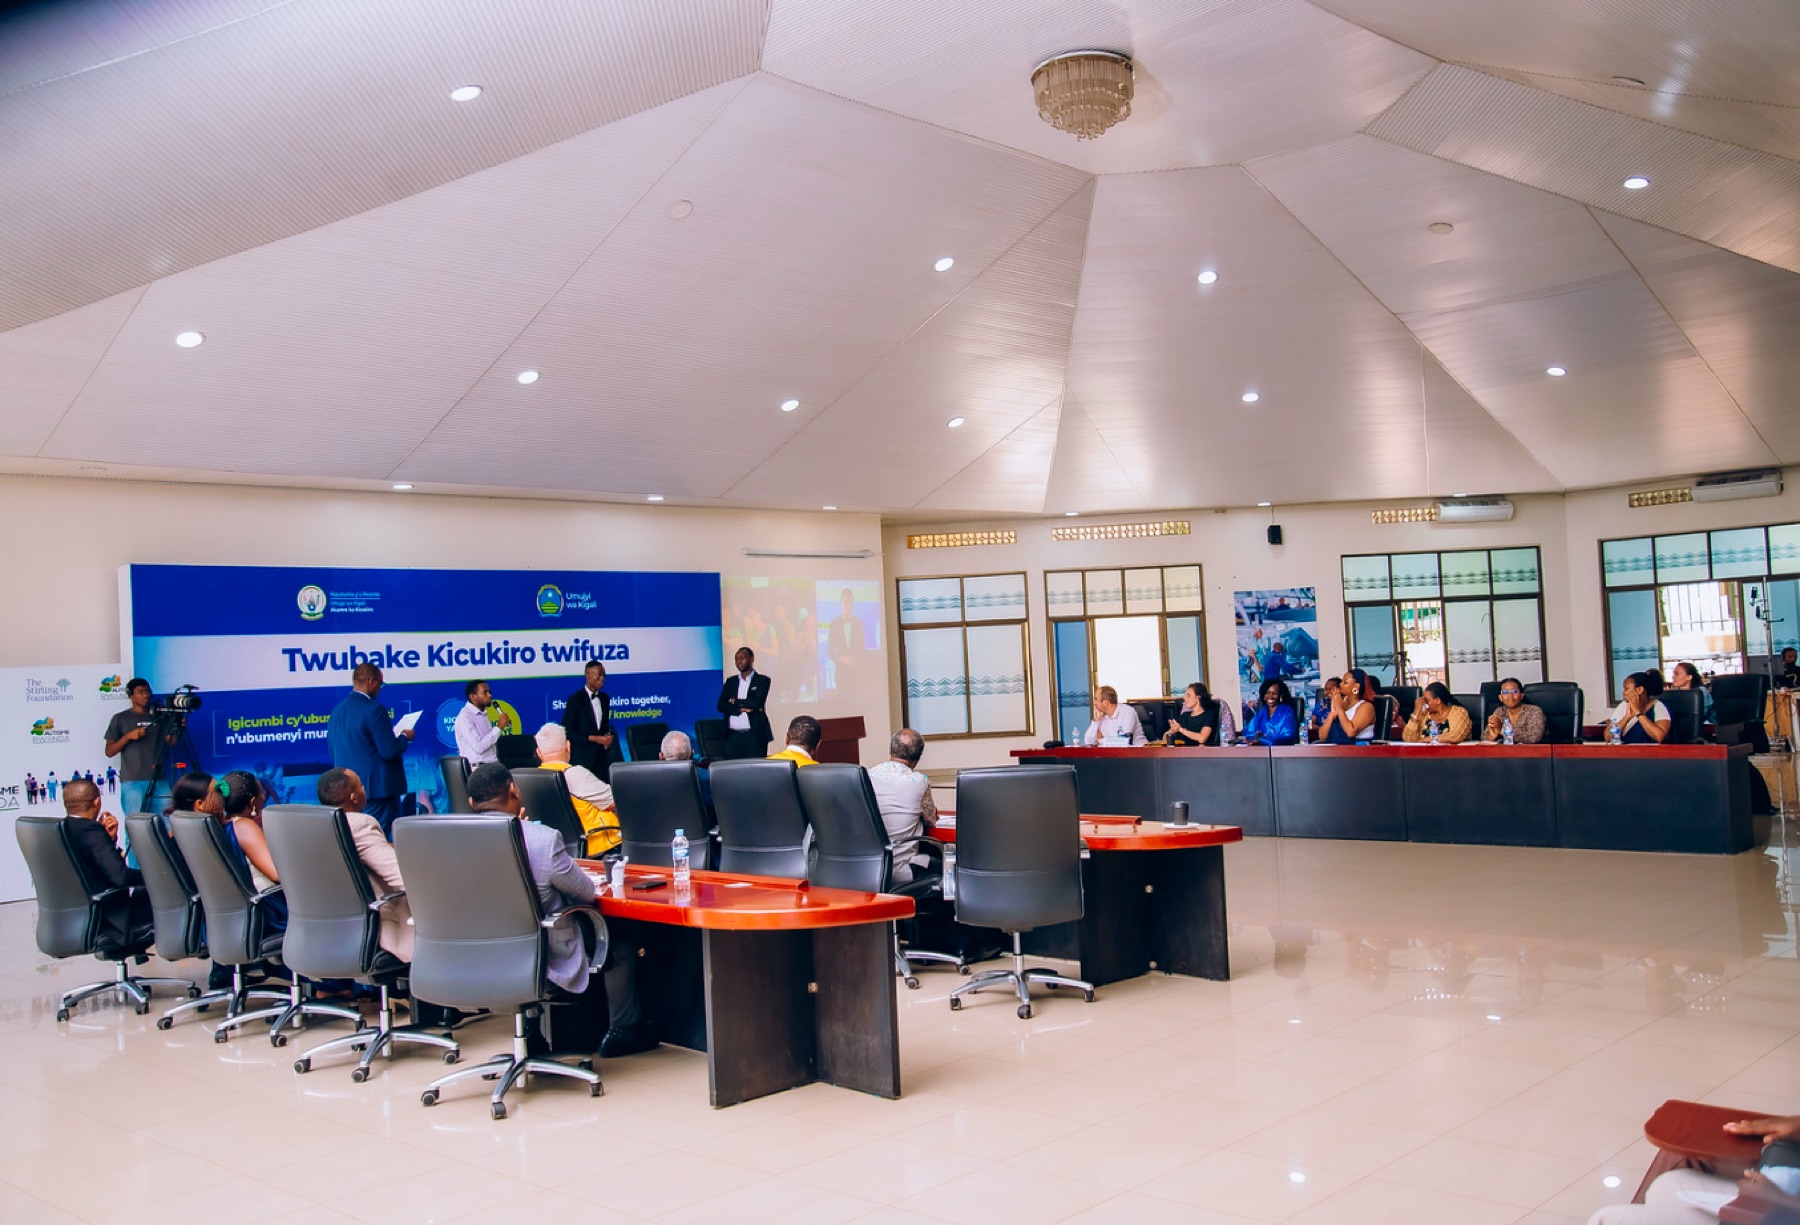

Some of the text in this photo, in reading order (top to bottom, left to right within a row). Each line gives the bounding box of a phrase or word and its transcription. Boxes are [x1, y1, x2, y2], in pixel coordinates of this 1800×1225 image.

[578, 601, 597, 610] Kigali
[282, 638, 630, 672] Twubake Kicukiro twifuza
[26, 679, 42, 687] The
[26, 686, 59, 695] Stirling
[27, 694, 74, 702] Foundation
[631, 695, 671, 707] together,
[613, 708, 663, 719] knowledge
[228, 714, 284, 731] Igicumbi
[226, 728, 302, 744] n'ubumenyi
